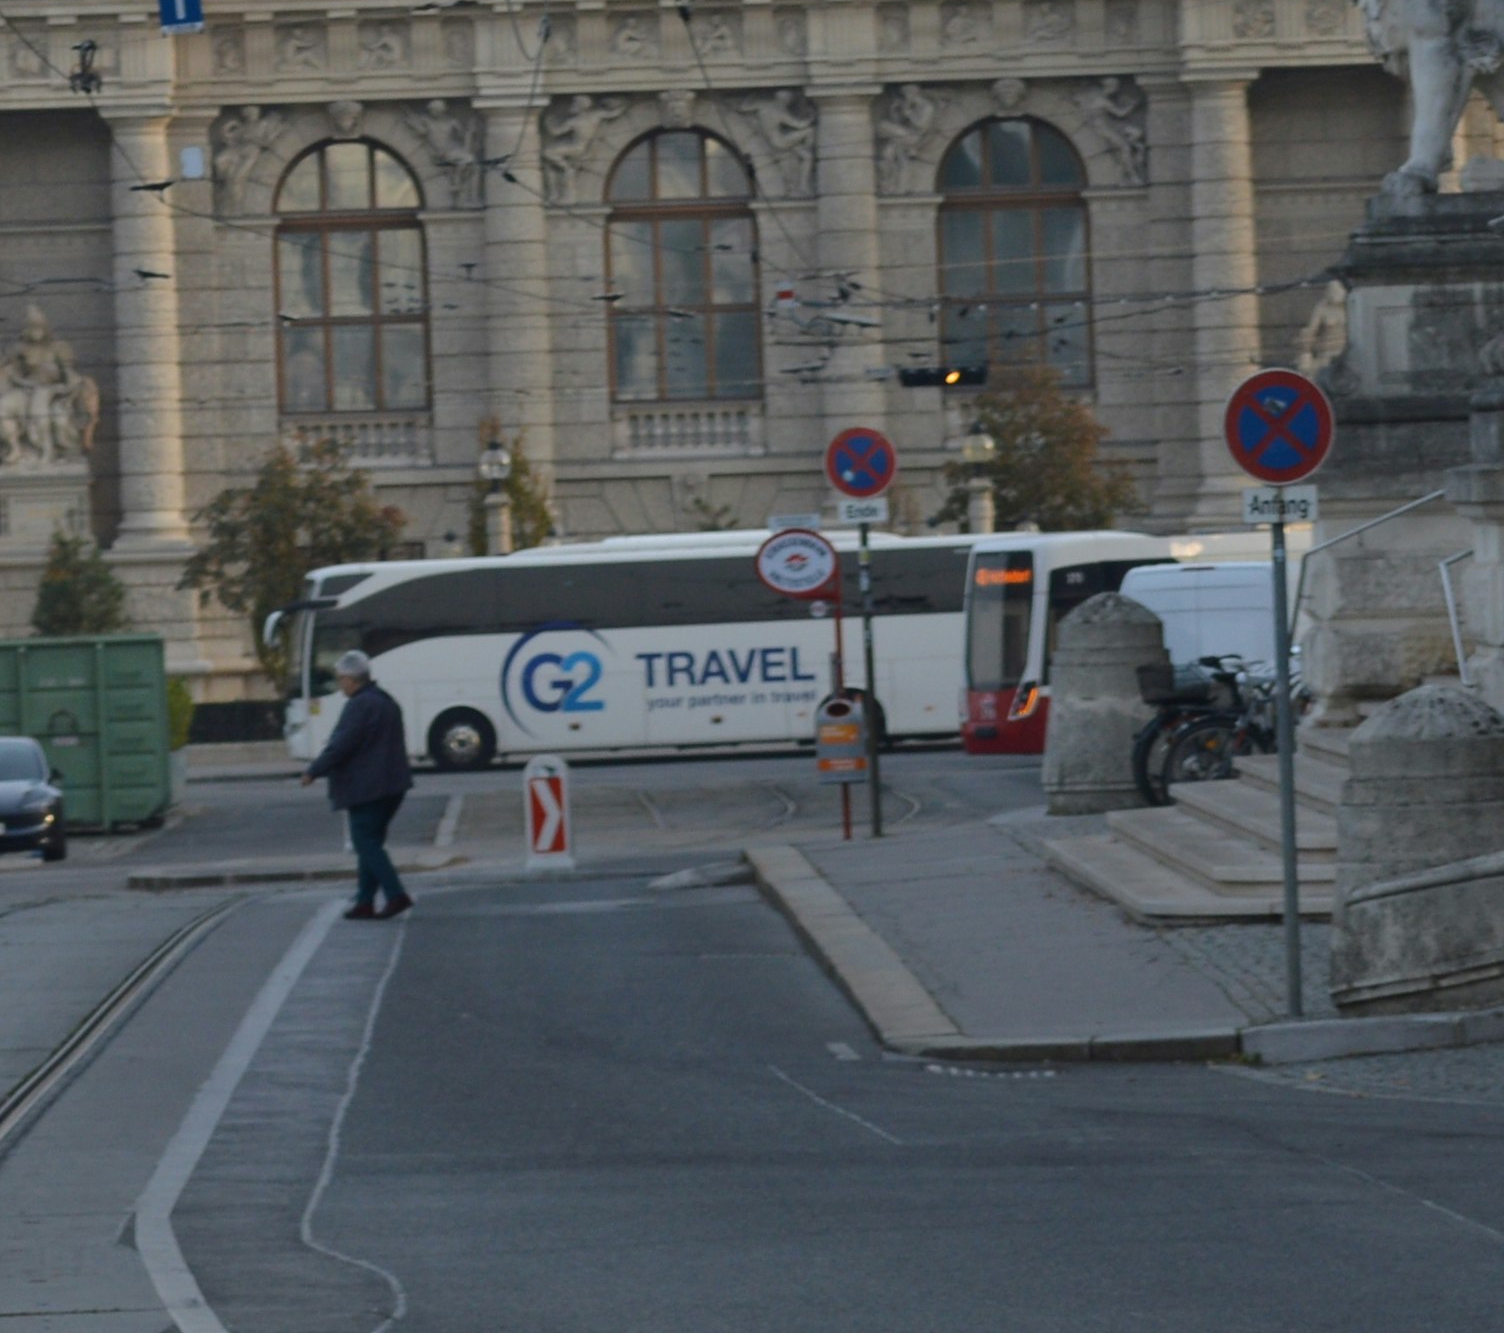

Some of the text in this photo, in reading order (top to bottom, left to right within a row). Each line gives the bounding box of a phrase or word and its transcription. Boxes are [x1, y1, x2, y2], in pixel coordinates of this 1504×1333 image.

[846, 504, 878, 519] Ende
[1249, 495, 1309, 519] Anfang
[635, 647, 815, 687] TRAVEL
[521, 651, 605, 713] G2
[647, 689, 816, 712] your partner in travel
